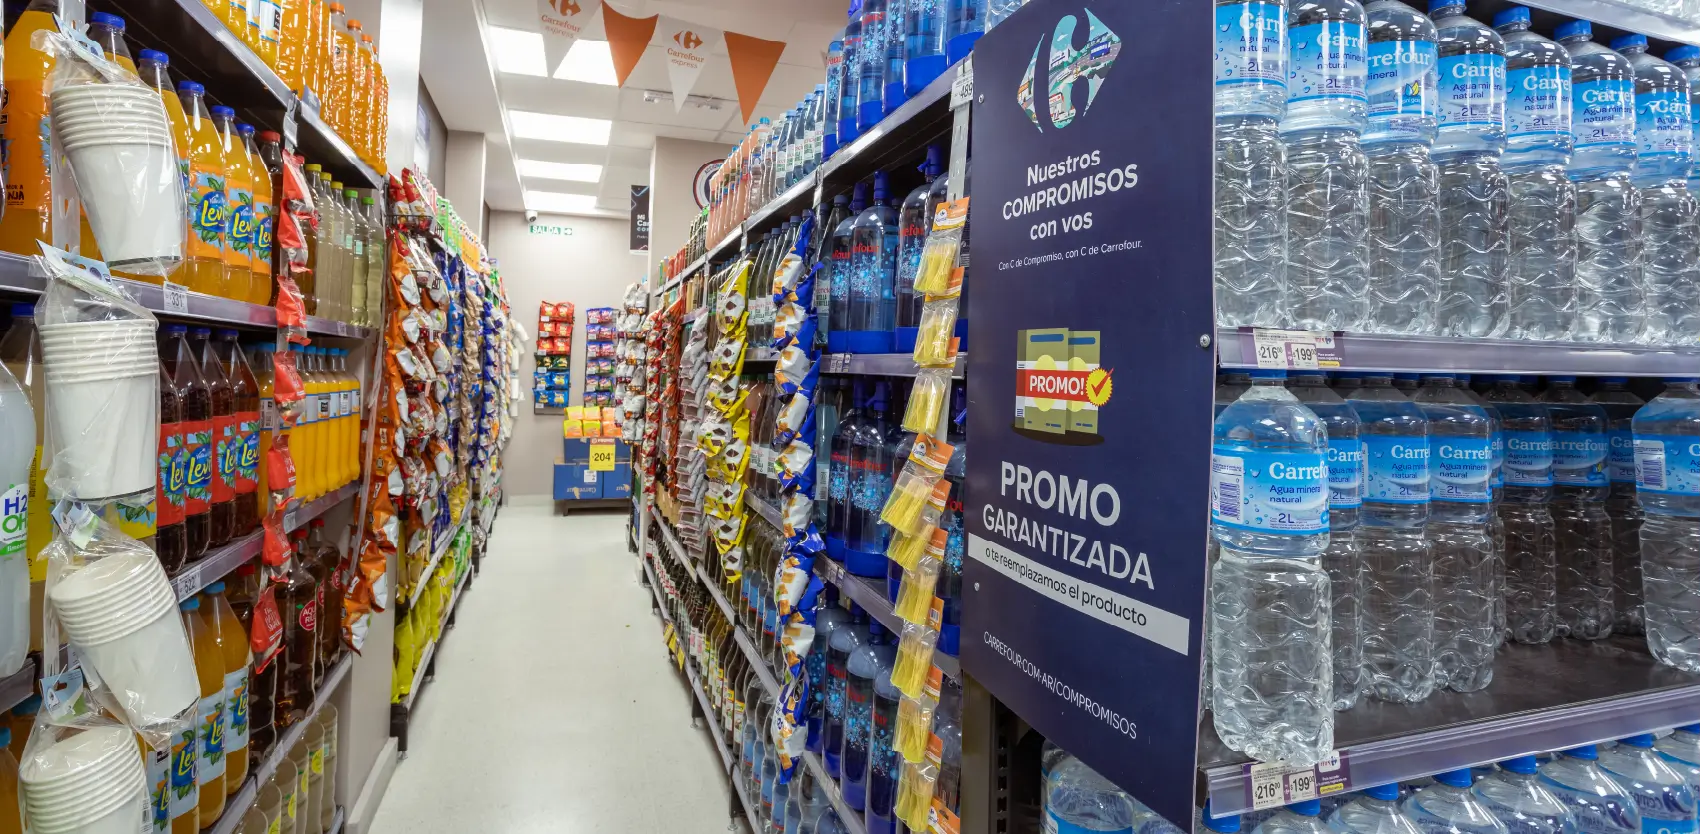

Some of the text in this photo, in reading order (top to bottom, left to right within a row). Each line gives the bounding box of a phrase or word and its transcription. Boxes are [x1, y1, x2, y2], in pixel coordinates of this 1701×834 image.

[541, 14, 581, 33] Carrefour
[544, 25, 574, 39] express
[667, 47, 705, 63] Carrefour
[671, 58, 698, 69] express
[1325, 78, 1342, 89] 2L
[1453, 82, 1477, 92] Agua
[1461, 106, 1478, 117] 2L
[1533, 117, 1549, 127] 2L
[1592, 129, 1609, 138] 2L
[1027, 149, 1101, 187] Nuestros
[1002, 163, 1138, 220] COMPROMISOS
[531, 225, 562, 235] SALIDA
[1030, 211, 1093, 240] con vos
[998, 239, 1143, 271] Con C de Compromiso, con C de Carrefour.
[1029, 375, 1085, 395] PROMO!
[594, 452, 611, 462] 204
[1391, 463, 1412, 471] Agua
[1440, 462, 1461, 470] Agua
[1440, 471, 1468, 479] natural
[1001, 460, 1121, 527] PROMO
[1269, 485, 1295, 495] Agua
[1399, 486, 1413, 496] 2L
[1446, 485, 1462, 494] 2L
[1332, 491, 1345, 500] 2L
[1278, 512, 1295, 524] 2L
[983, 503, 1155, 590] GARANTIZADA
[985, 547, 1148, 627] o te reemplazamos el producto
